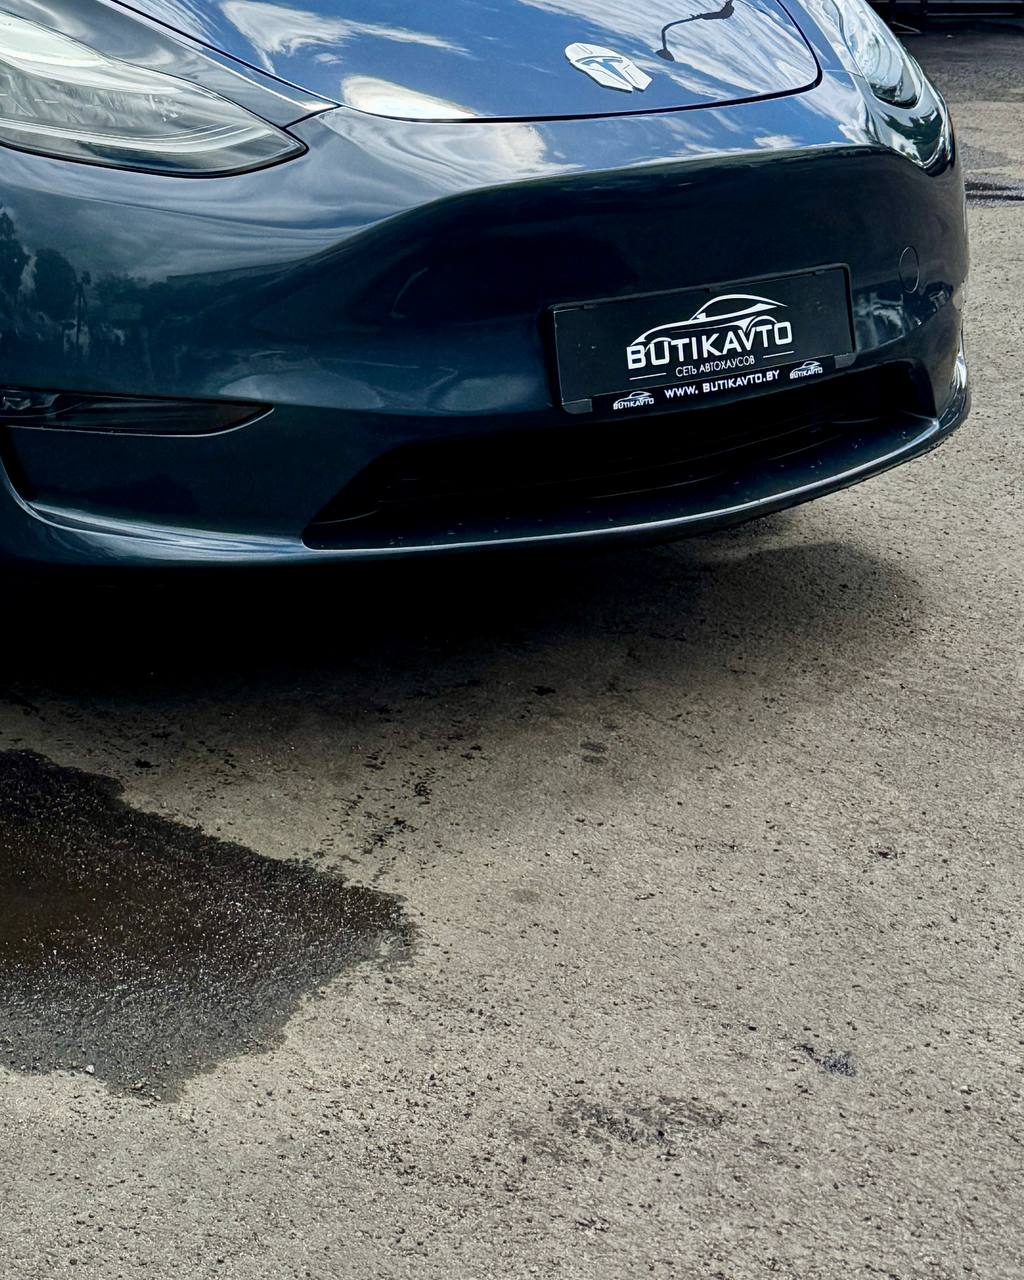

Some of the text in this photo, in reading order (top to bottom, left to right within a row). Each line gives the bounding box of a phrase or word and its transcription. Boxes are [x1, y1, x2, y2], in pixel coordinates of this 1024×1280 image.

[626, 321, 793, 370] BUTIKAVTO
[675, 355, 755, 377] СЕТЬ АВТОХАУСОВ
[664, 370, 780, 399] WWW. BUTIKAVTO.BY
[613, 397, 655, 410] BUTIKAVTO
